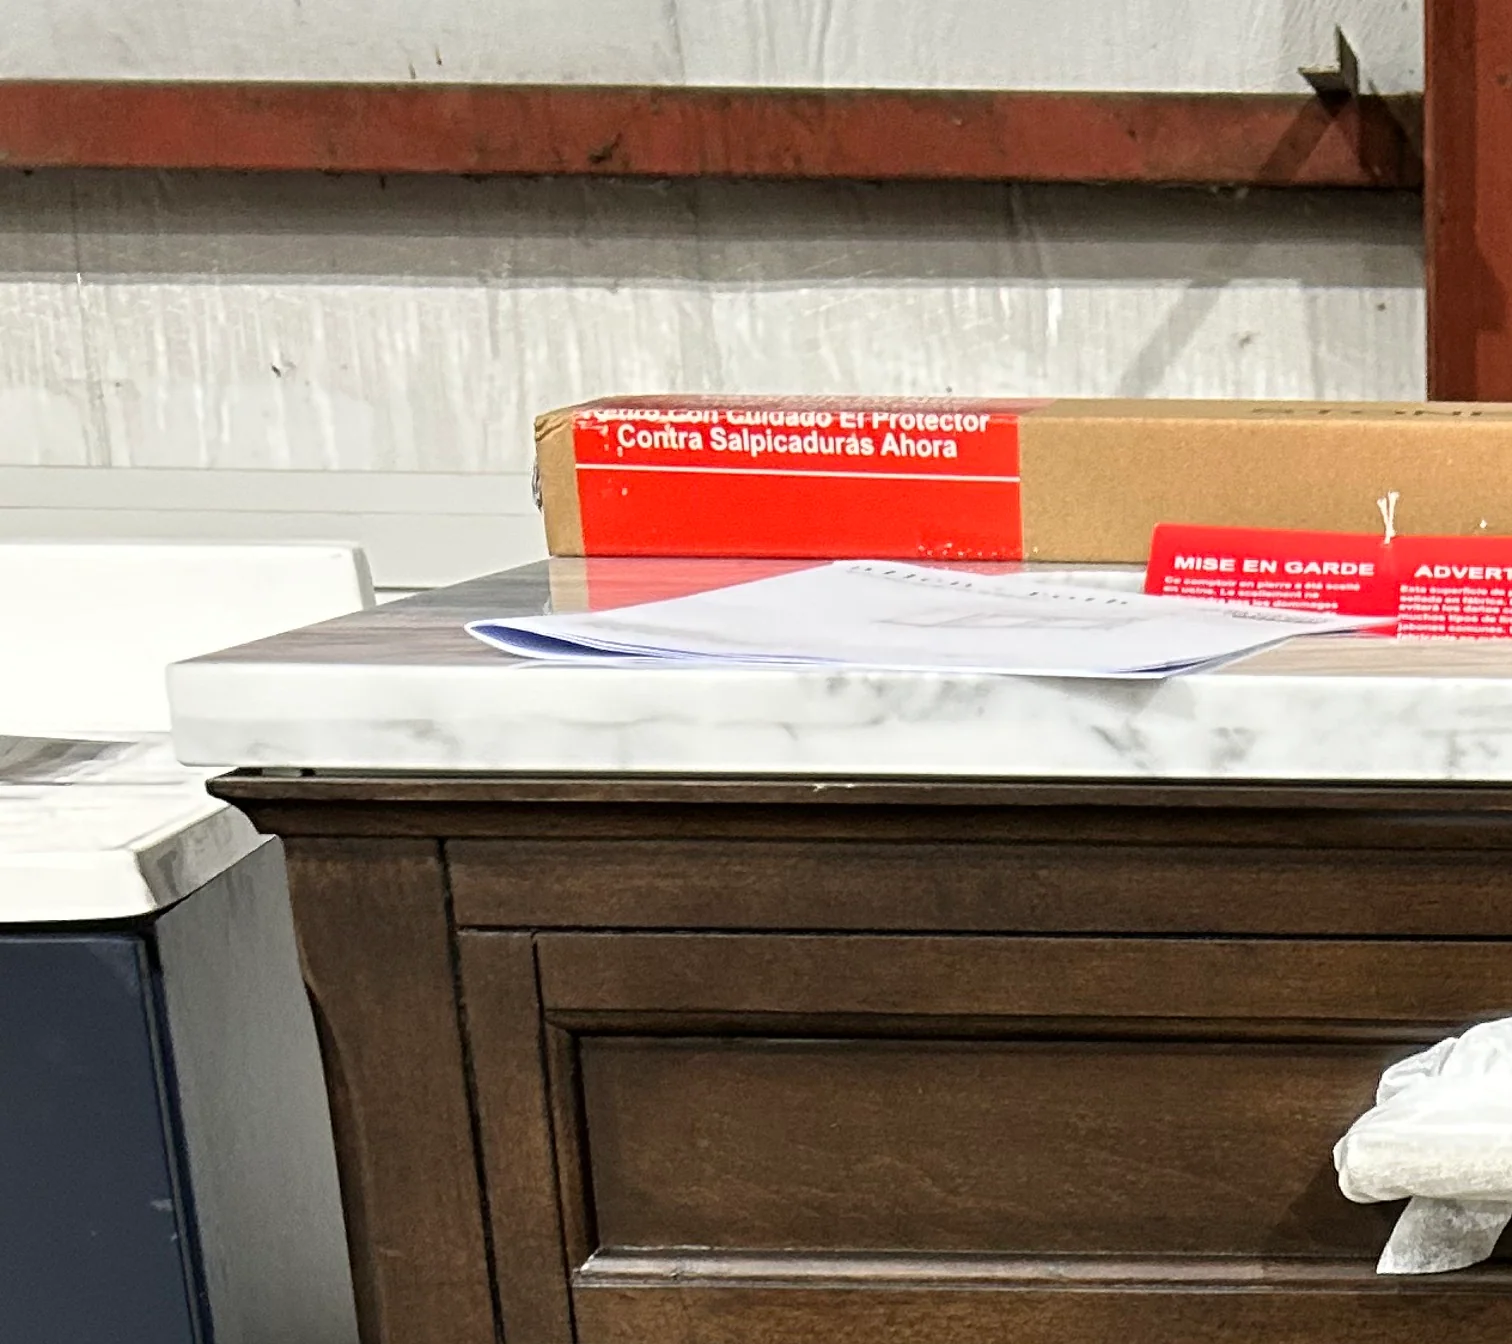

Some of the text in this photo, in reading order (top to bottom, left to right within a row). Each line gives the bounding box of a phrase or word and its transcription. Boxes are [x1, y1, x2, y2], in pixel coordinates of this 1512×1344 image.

[872, 412, 990, 433] Protector
[617, 423, 704, 451] Contra
[880, 432, 958, 458] Ahora
[1174, 556, 1375, 577] MISE EN GARDE
